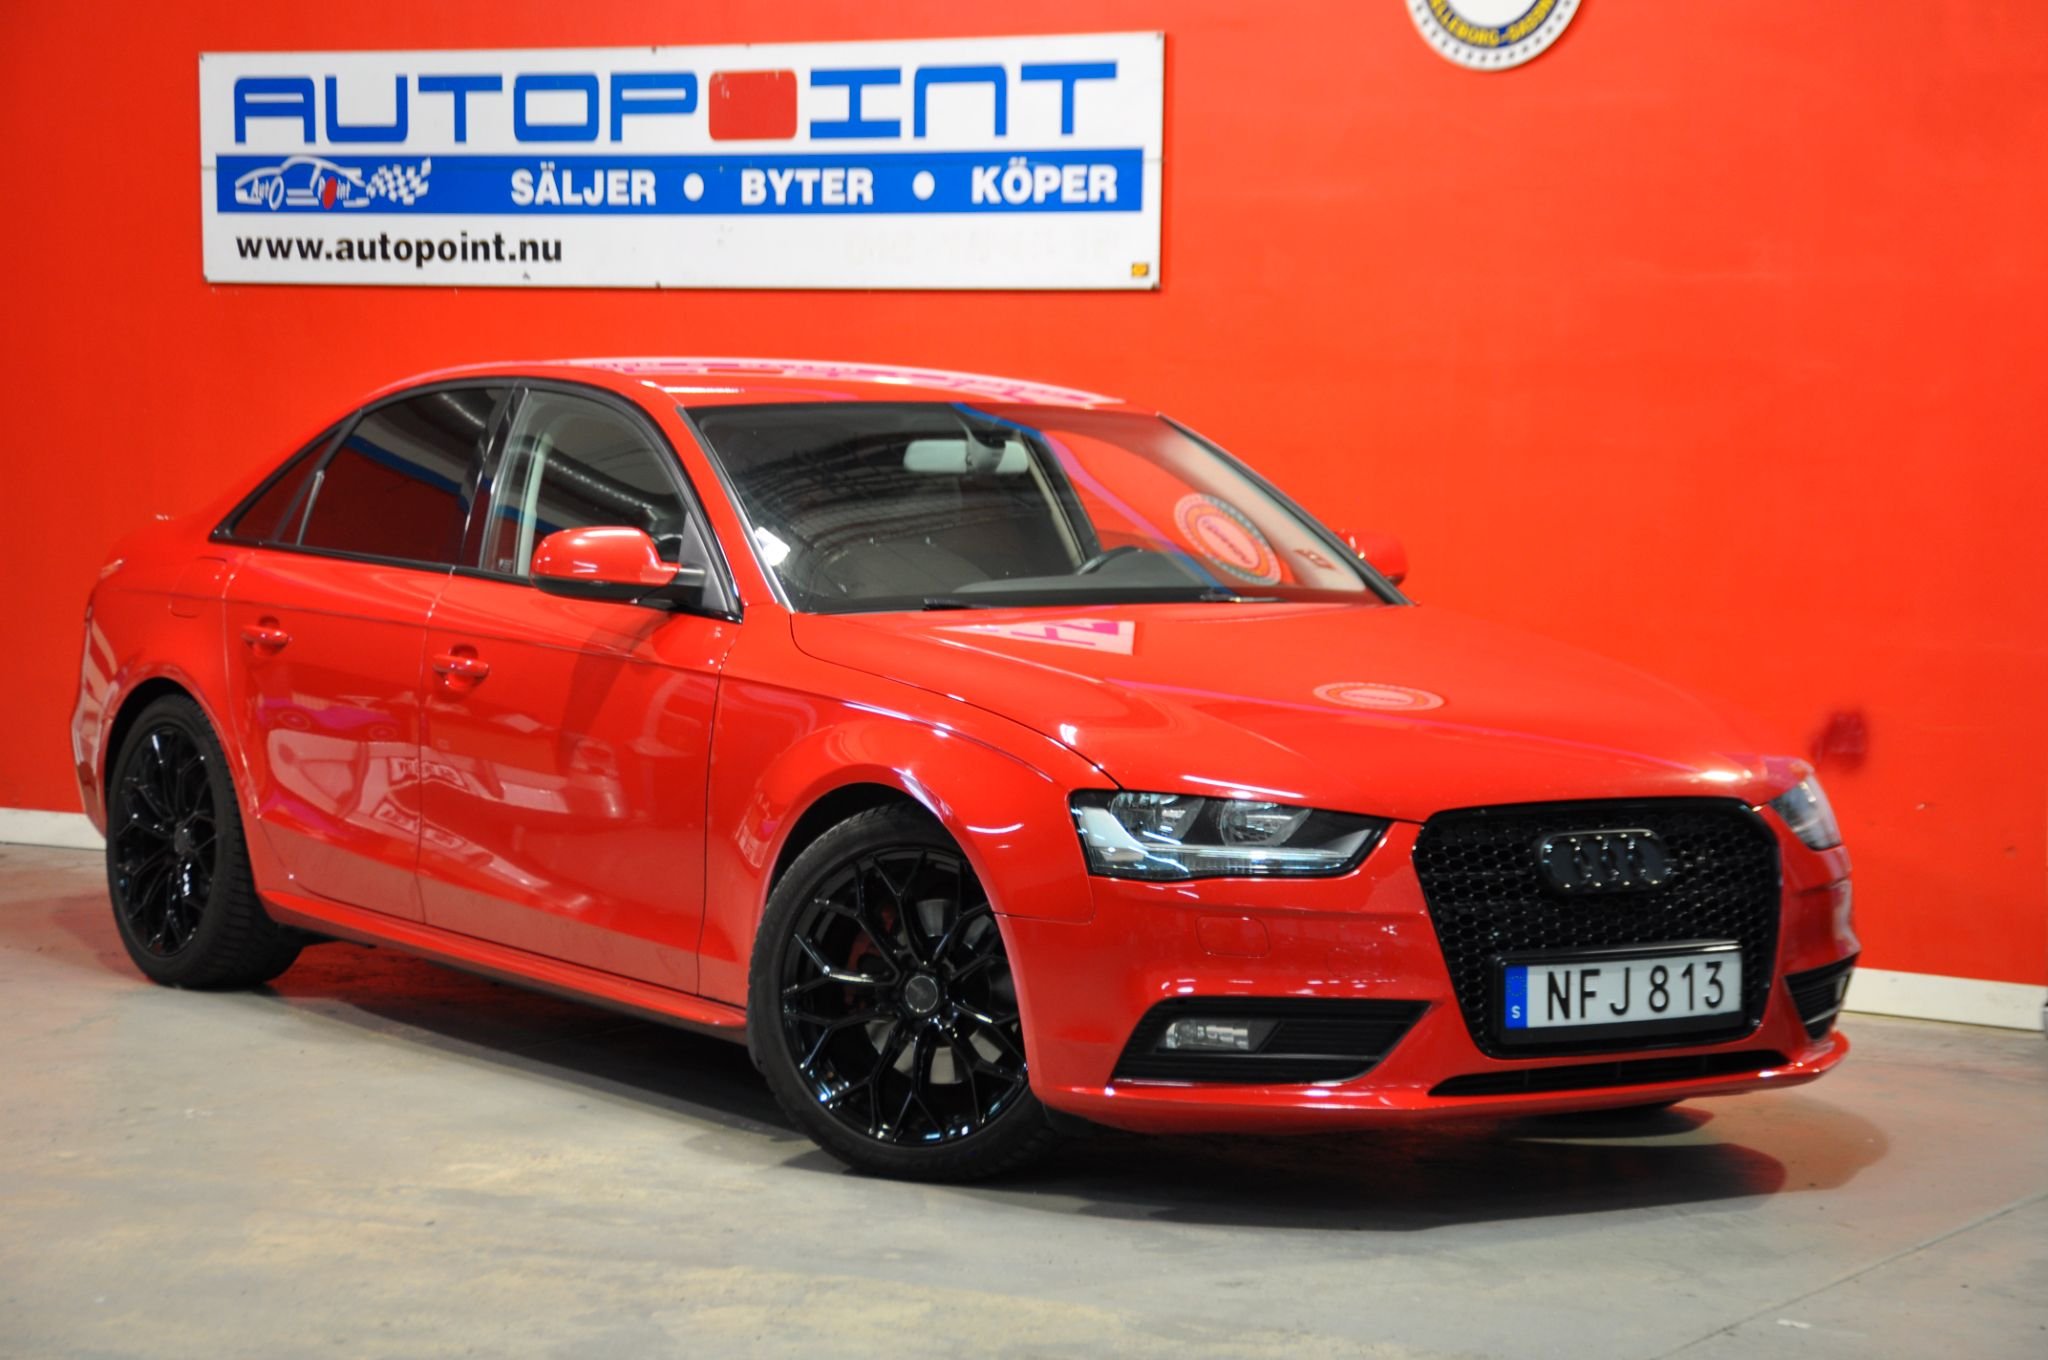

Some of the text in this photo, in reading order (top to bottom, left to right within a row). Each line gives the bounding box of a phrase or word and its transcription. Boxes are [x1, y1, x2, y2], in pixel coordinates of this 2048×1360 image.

[511, 157, 1118, 206] SÄLJER BYTER KÖPER
[236, 232, 562, 268] www.autopoint.nu
[1547, 960, 1725, 1021] NFJ 813
